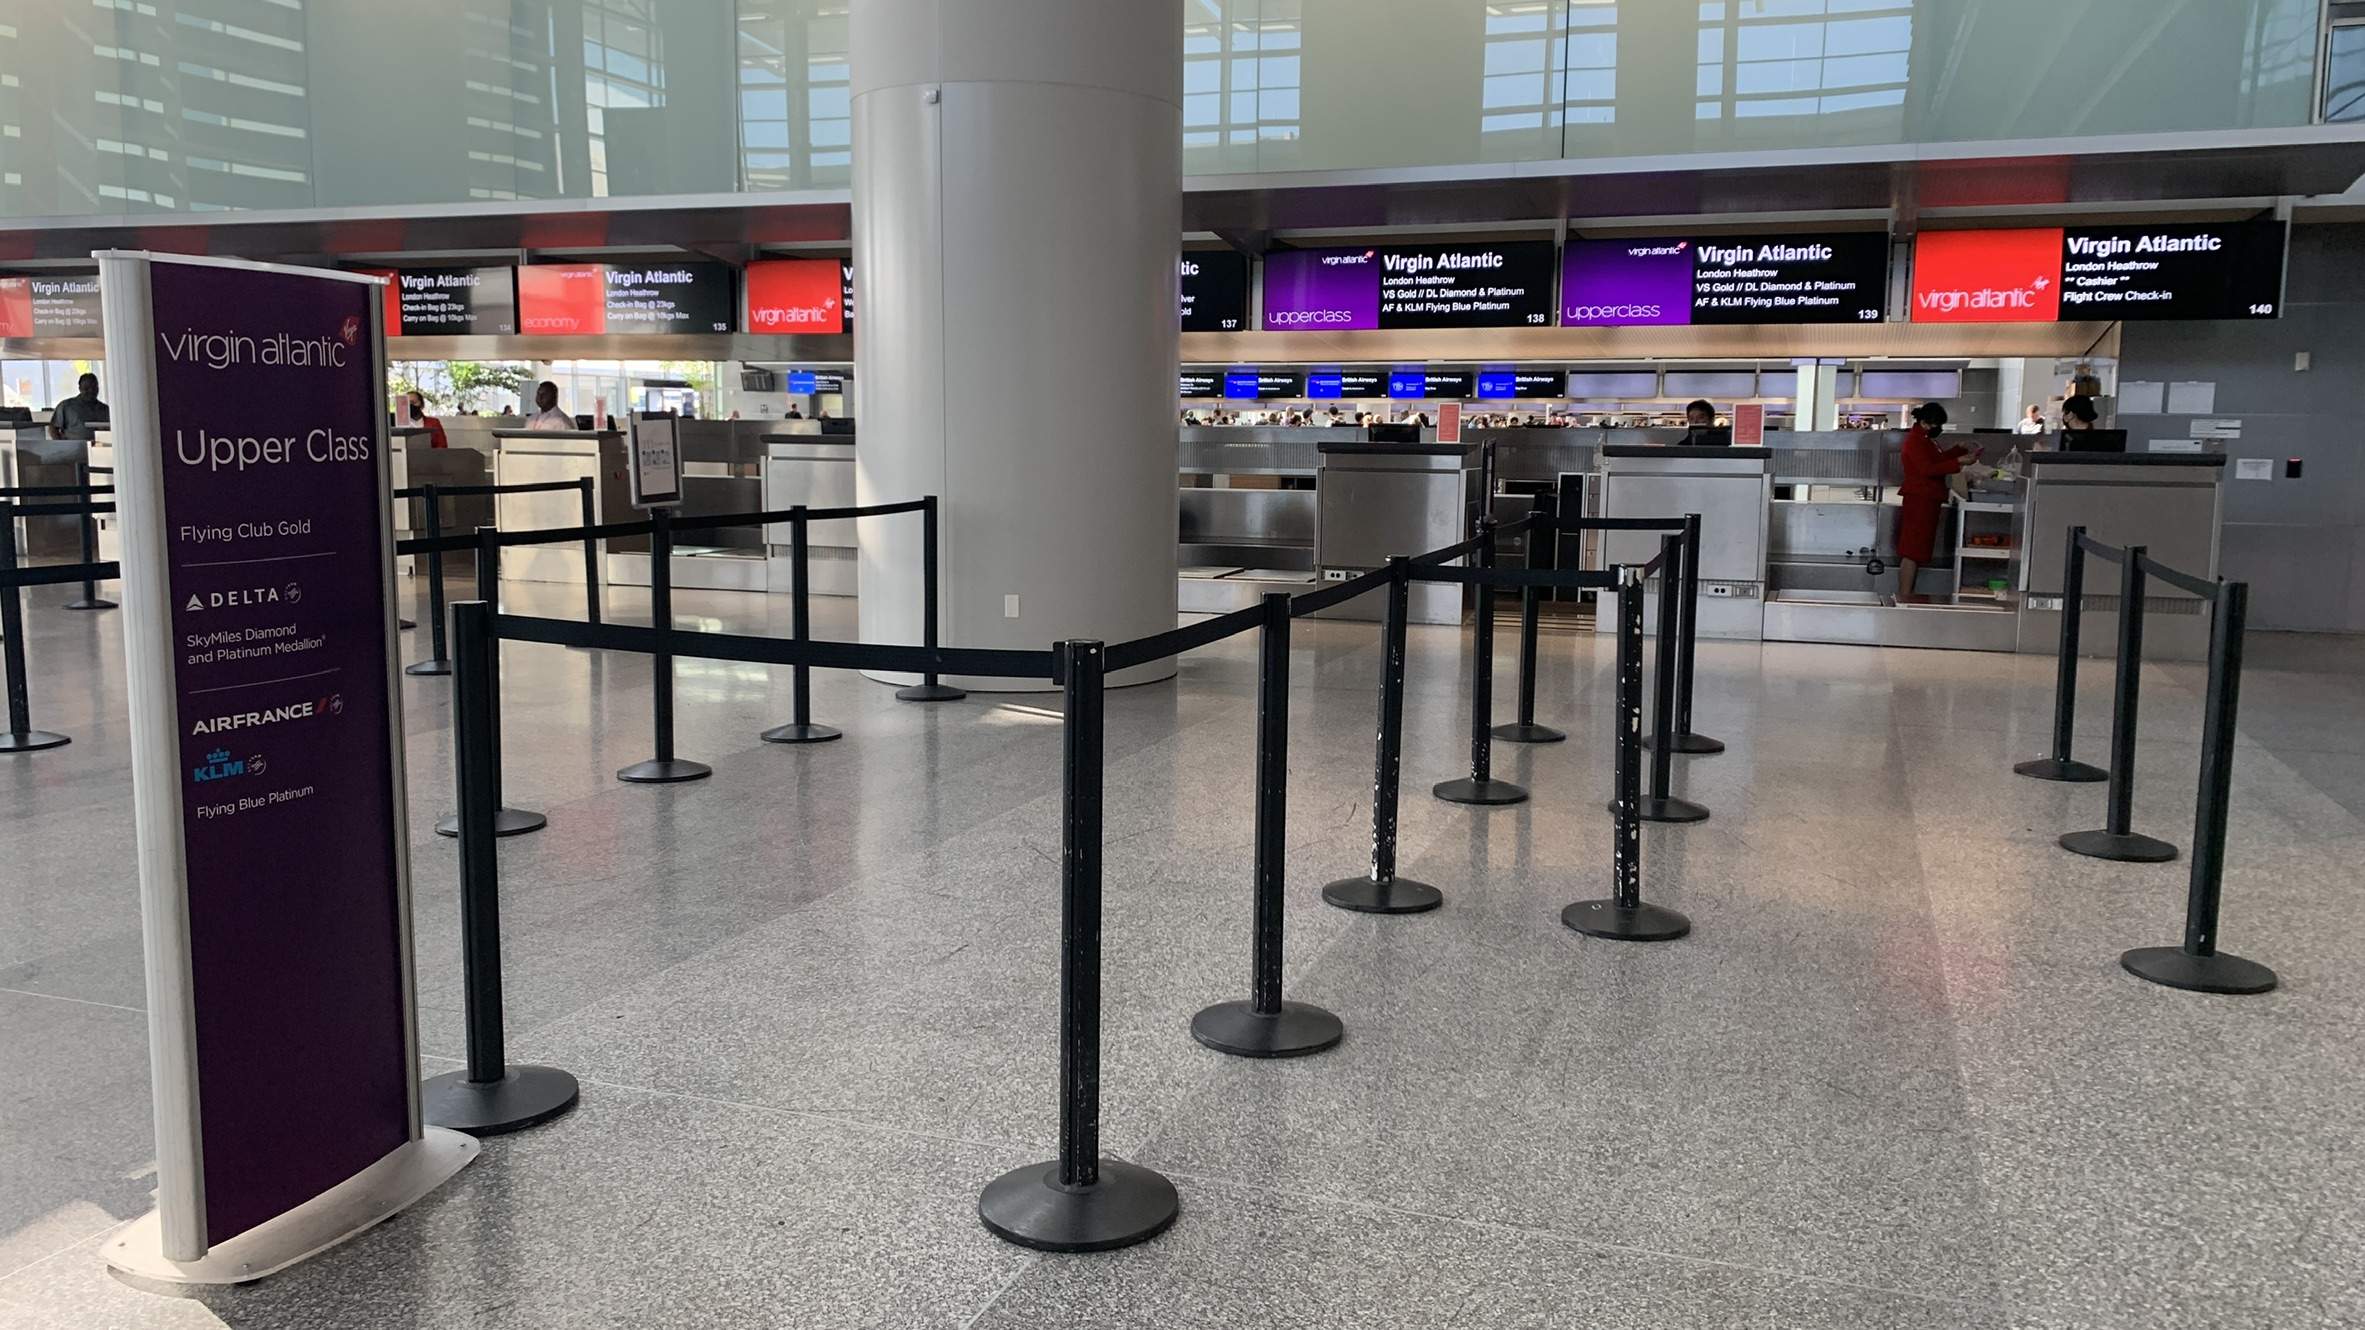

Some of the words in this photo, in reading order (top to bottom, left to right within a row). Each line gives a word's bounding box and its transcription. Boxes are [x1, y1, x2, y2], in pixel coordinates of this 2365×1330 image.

[1628, 247, 1651, 256] virgin
[1651, 247, 1680, 255] atlantic
[2067, 237, 2131, 257] Virgin
[2135, 234, 2221, 252] Atlantic
[1322, 257, 1342, 265] virgin
[1342, 256, 1368, 264] atlantic
[1698, 246, 1753, 265] Virgin
[1758, 244, 1832, 261] Atlantic
[1384, 254, 1432, 273] Virgin
[1437, 252, 1503, 268] Atlantic
[2065, 263, 2105, 272] London
[2107, 261, 2159, 270] Heathrow
[606, 271, 642, 286] Virgin
[645, 271, 693, 283] Atlantic
[1697, 270, 1731, 278] London
[1734, 269, 1778, 277] Heathrow
[401, 276, 434, 290] Virgin
[437, 275, 480, 287] Atlantic
[1383, 277, 1413, 285] London
[1416, 276, 1455, 285] Heathrow
[1697, 283, 1710, 292] VS
[1713, 283, 1734, 292] Gold
[1745, 283, 1758, 291] DL
[1760, 282, 1801, 291] Diamond
[1804, 282, 1812, 290] &
[1815, 281, 1855, 290] Platinum
[2077, 277, 2117, 286] Cashier
[32, 282, 60, 295] Virgin
[63, 282, 99, 292] Atlantic
[630, 289, 659, 297] Heathrow
[1383, 290, 1395, 299] VS
[1398, 289, 1416, 298] Gold
[1426, 289, 1438, 298] DL
[1440, 288, 1476, 297] Diamond
[1479, 288, 1485, 296] &
[1488, 287, 1524, 296] Platinum
[1696, 298, 1708, 306] AF
[1711, 298, 1718, 306] &
[1721, 298, 1742, 306] KLM
[1745, 297, 1771, 307] Flying
[1774, 297, 1795, 305] Blue
[1798, 296, 1839, 305] Platinum
[1919, 289, 1969, 312] virgin
[1970, 288, 2035, 308] atlantic
[2063, 292, 2093, 304] Flight
[2095, 291, 2123, 301] Crew
[2125, 290, 2172, 300] Check-in
[428, 304, 439, 312] Bag
[634, 301, 647, 309] Bag
[648, 301, 655, 309] @
[657, 301, 675, 309] 23kgs
[1383, 304, 1394, 312] AF
[1396, 304, 1402, 312] &
[1405, 303, 1423, 311] KLM
[1426, 303, 1450, 313] Flying
[1452, 303, 1471, 311] Blue
[1473, 302, 1509, 310] Platinum
[2249, 304, 2272, 314] 140
[608, 313, 624, 321] Carry
[648, 312, 655, 320] @
[753, 307, 785, 325] virgin
[786, 307, 827, 322] atlantic
[1269, 310, 1351, 325] upperclass
[1567, 304, 1660, 320] upperclass
[1858, 310, 1878, 319] 139
[403, 315, 418, 323] Carry
[524, 317, 579, 329] economy
[1222, 320, 1237, 328] 137
[1527, 314, 1544, 323] 138
[161, 328, 256, 369] virgin
[262, 333, 345, 367] atlantic
[177, 429, 296, 471] Upper
[307, 429, 369, 462] Class
[181, 525, 232, 543] Flying
[238, 522, 273, 537] Club
[278, 519, 310, 535] Gold
[211, 588, 279, 607] DELTA
[187, 631, 241, 648] SkyMiles
[245, 623, 296, 640] Diamond
[188, 651, 213, 664] and
[218, 646, 271, 661] Platinum
[192, 702, 313, 735] AIRFRANCE
[194, 761, 243, 782] KLM
[198, 803, 235, 818] Flying
[239, 797, 265, 810] Blue
[269, 786, 313, 804] Platinum
